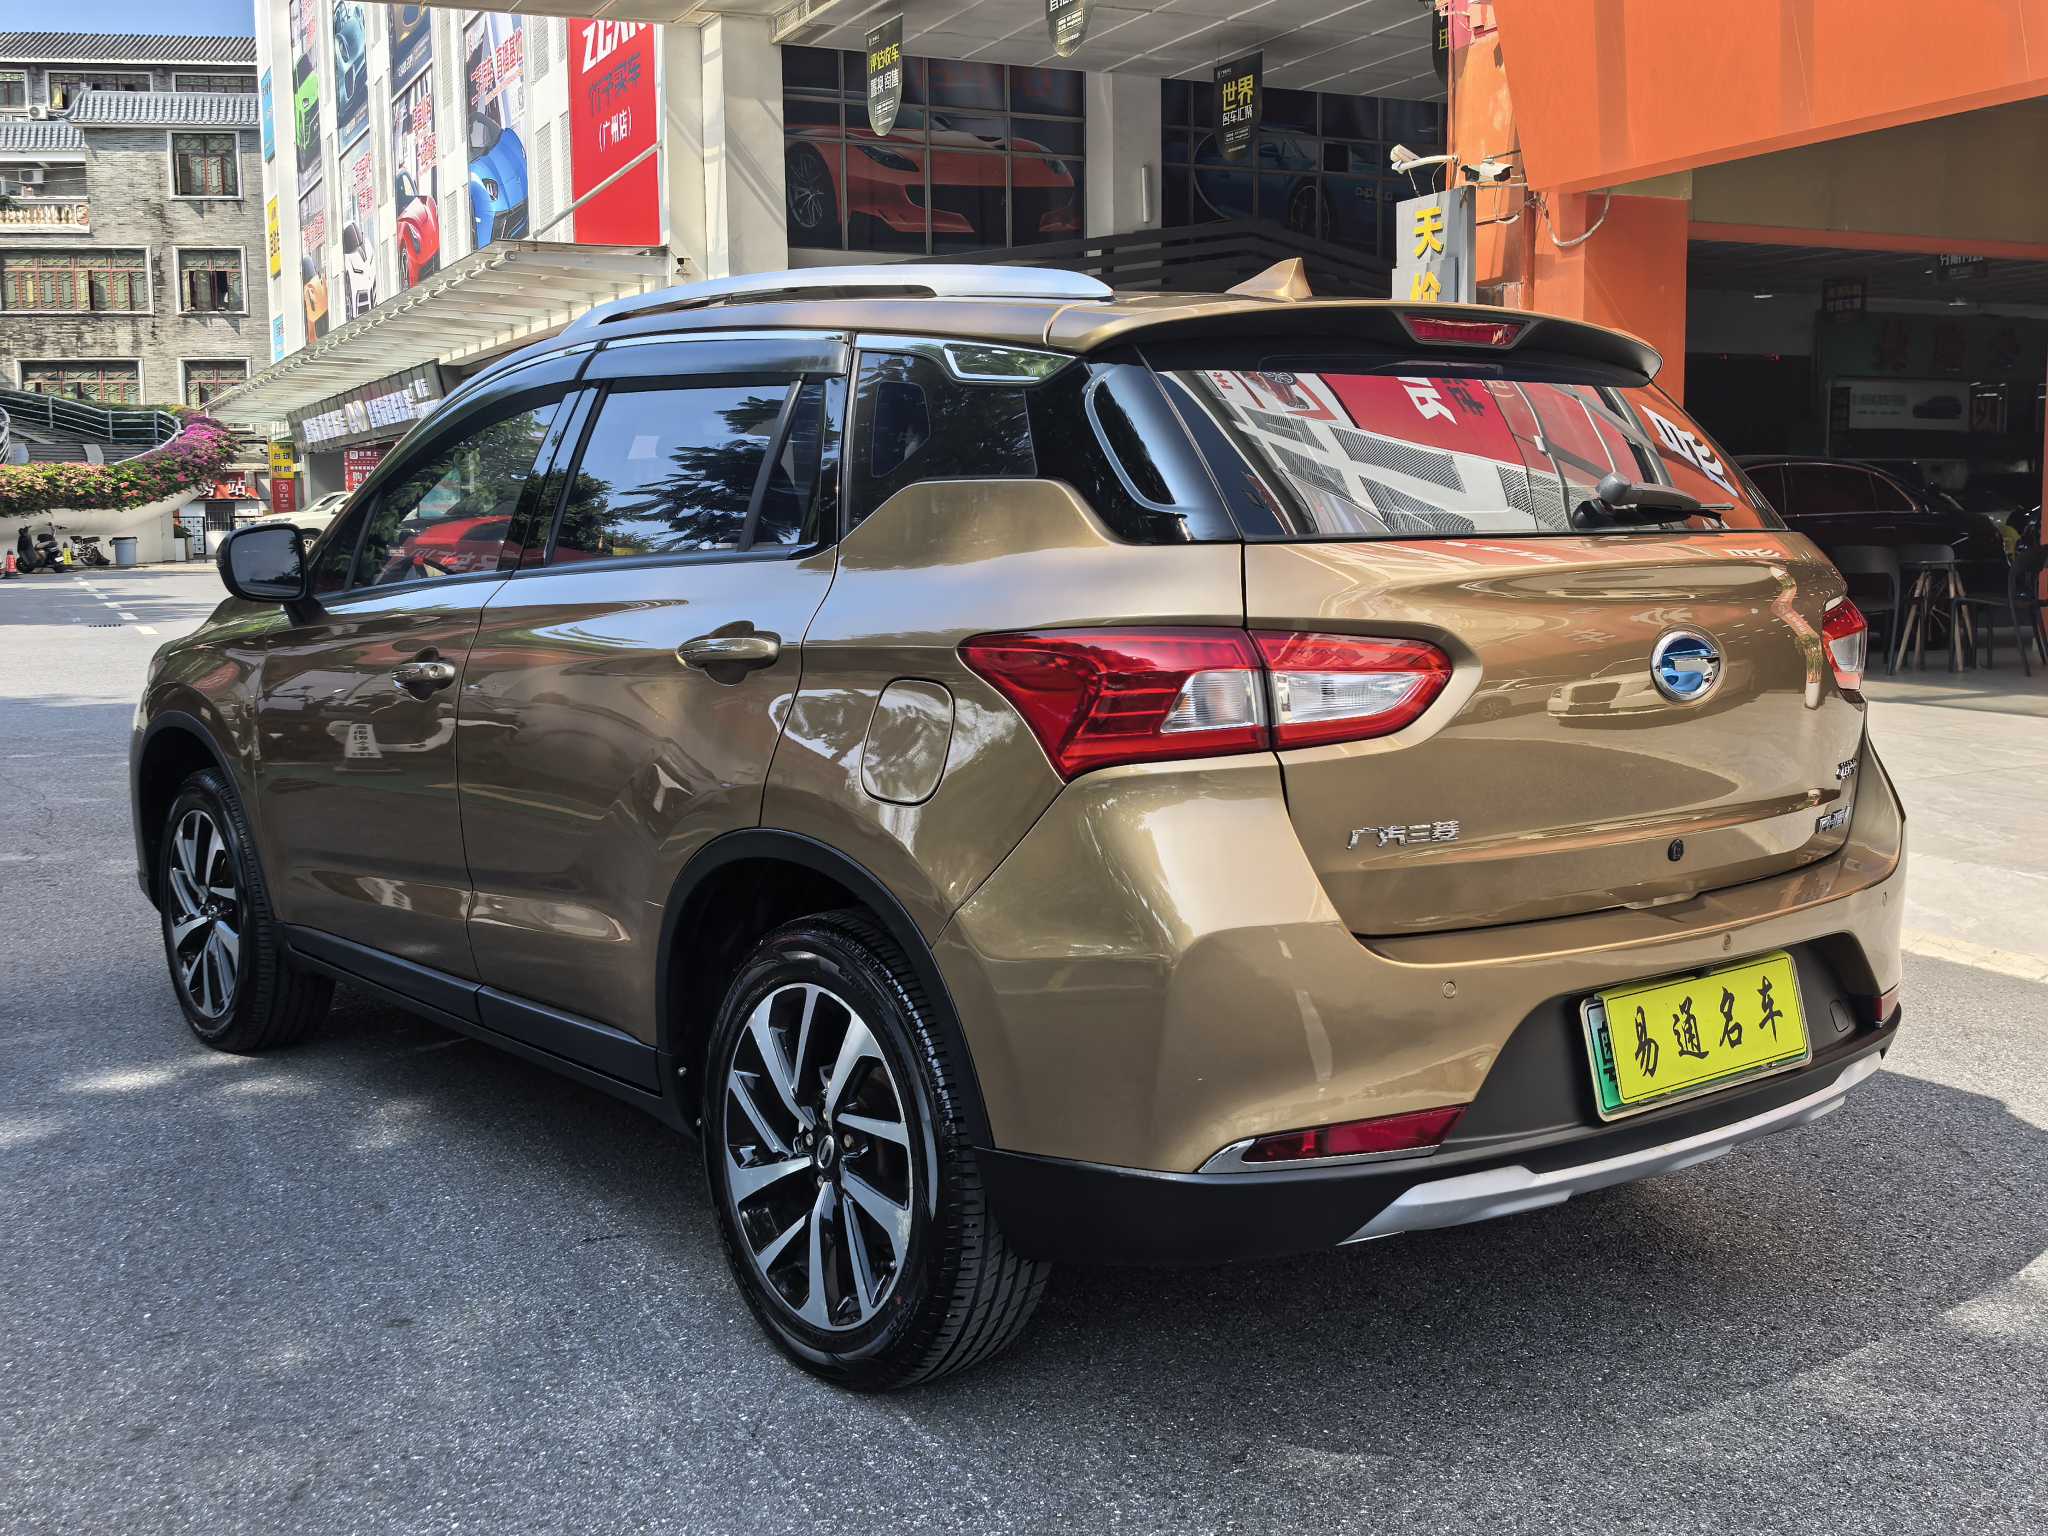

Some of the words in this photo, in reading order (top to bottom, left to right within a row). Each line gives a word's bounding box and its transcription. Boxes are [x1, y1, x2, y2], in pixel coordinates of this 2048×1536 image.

[1222, 74, 1254, 112] 世界
[599, 105, 632, 153] (广州店)
[1345, 820, 1460, 850] 广汽三菱
[1635, 976, 1783, 1078] 易通名车
